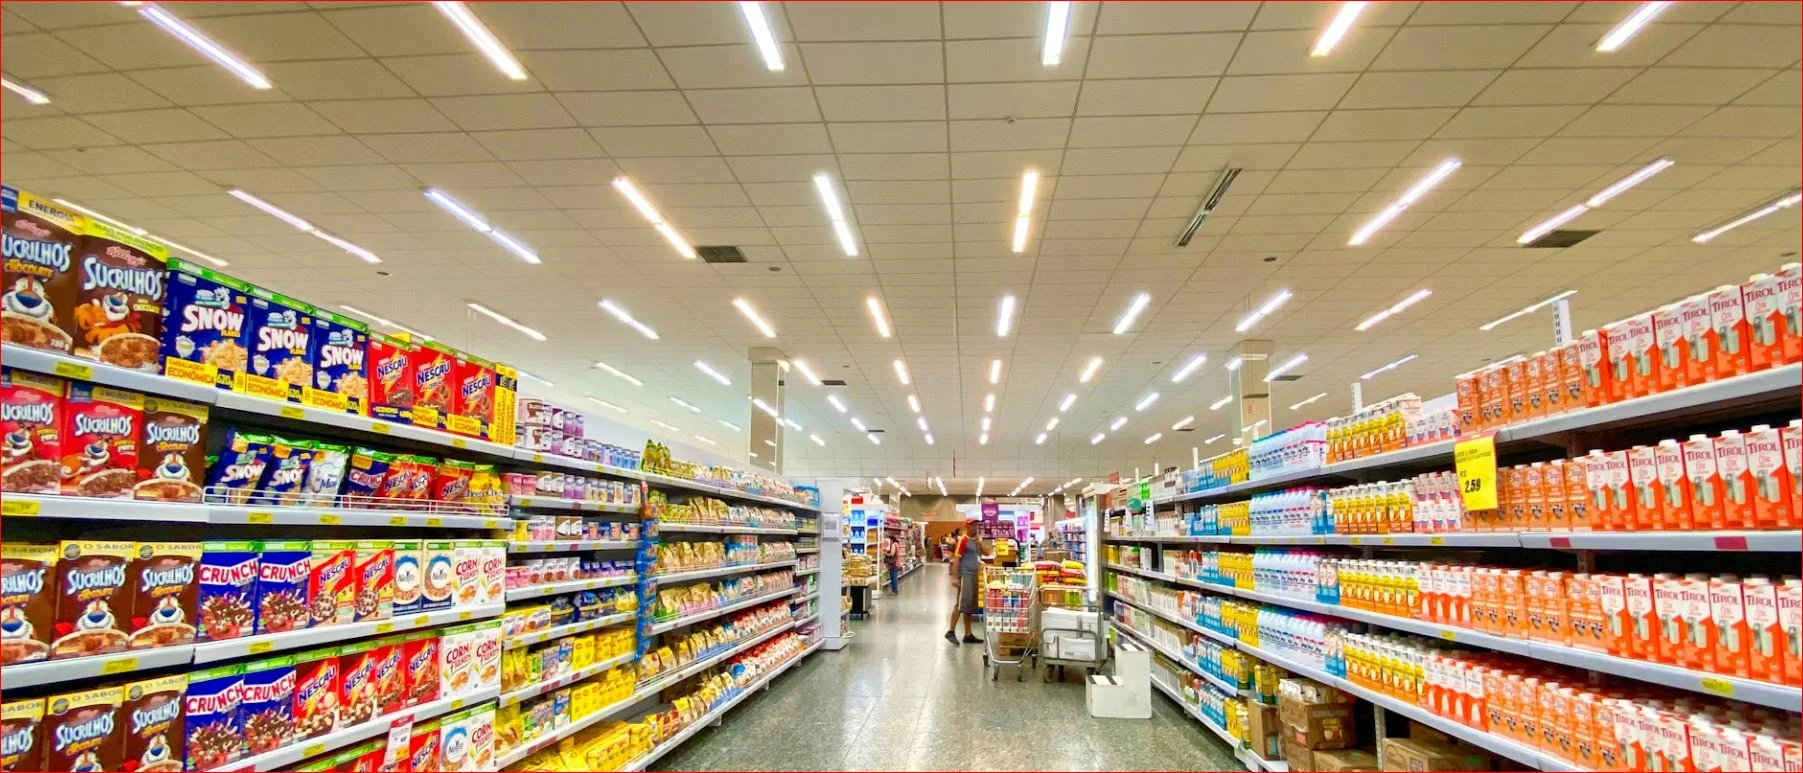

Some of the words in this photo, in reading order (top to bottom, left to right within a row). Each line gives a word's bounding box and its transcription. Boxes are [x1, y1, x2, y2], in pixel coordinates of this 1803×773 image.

[83, 256, 163, 300] SUCRILHOS
[1712, 298, 1739, 312] TIROL
[1745, 288, 1776, 303] TIROL
[181, 304, 244, 333] SNOW
[1656, 317, 1679, 330] TIROL
[1683, 308, 1709, 323] TIROL
[257, 327, 309, 352] SNOW
[1630, 325, 1650, 338] TIROL
[320, 345, 364, 368] SNOW
[377, 356, 407, 378] NESCAU
[417, 360, 450, 386] NESCAU
[462, 375, 491, 398] NESCAU
[75, 413, 132, 436] SUCRILHOS
[146, 422, 199, 445] SUCRILHOS
[1686, 451, 1714, 462] TIROL
[1716, 447, 1745, 458] TIROL
[1747, 442, 1778, 454] TIROL
[1631, 457, 1654, 468] TIROL
[1657, 454, 1680, 465] TIROL
[220, 462, 266, 482] SNOW
[200, 560, 258, 584] CRUNCH
[260, 559, 311, 580] CRUNCH
[319, 558, 349, 583] NESCAU
[363, 556, 390, 580] NESCAU
[456, 558, 478, 576] CORN
[483, 556, 503, 573] CORN
[67, 563, 126, 595] SUCRILHOS
[141, 563, 195, 593] SUCRILHOS
[1602, 585, 1621, 597] TIROL
[1627, 587, 1648, 598] TIROL
[1656, 589, 1679, 601] TIROL
[1680, 591, 1707, 603] TIROL
[1711, 593, 1739, 605] TIROL
[1746, 595, 1774, 607] TIROL
[409, 644, 434, 672] NESCAU
[446, 643, 469, 665] CORN
[476, 639, 498, 657] CORN
[344, 658, 375, 692] NESCAU
[244, 675, 296, 702] CRUNCH
[298, 667, 335, 704] NESCAU
[187, 684, 244, 713] CRUNCH
[132, 697, 180, 734] SUCRILHOS
[56, 710, 115, 751] SUCRILHOS
[471, 723, 492, 743] CORN
[1661, 727, 1683, 742] TIROL
[1690, 736, 1716, 750] TIROL
[1719, 743, 1745, 759] TIROL
[1751, 752, 1780, 768] TIROL
